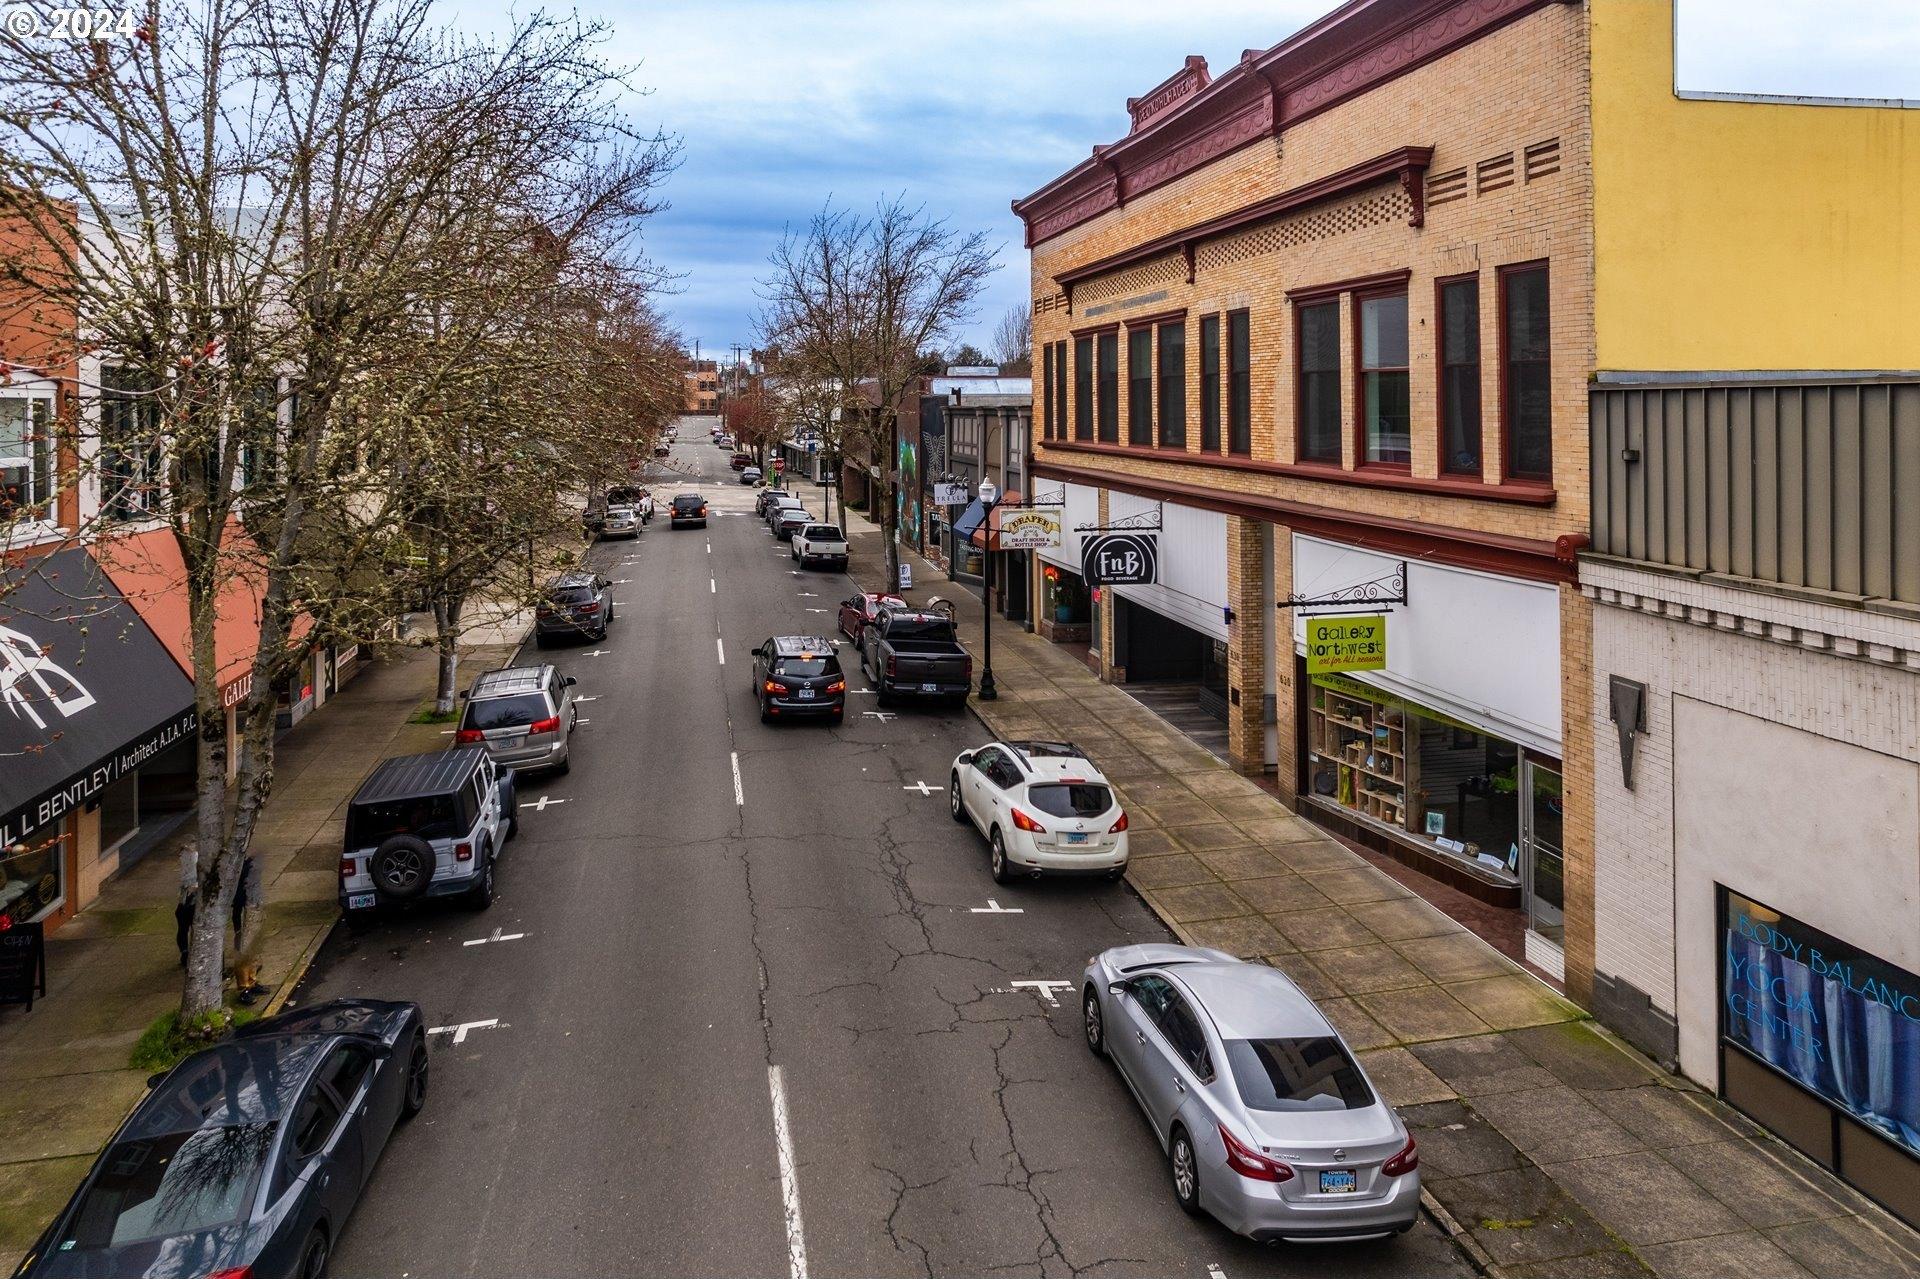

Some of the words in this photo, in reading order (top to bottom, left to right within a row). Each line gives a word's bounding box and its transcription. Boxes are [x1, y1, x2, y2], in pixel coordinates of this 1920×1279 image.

[1011, 514, 1050, 528] DRAPER
[1101, 551, 1140, 576] FnB
[1330, 656, 1342, 667] for
[1356, 655, 1383, 663] reasons
[22, 814, 34, 836] L
[38, 762, 112, 826] BENTLEY
[121, 736, 158, 774] Architect
[160, 723, 182, 749] A.I.A.
[1738, 913, 1803, 961] BODY
[1727, 949, 1819, 1024] YOGA
[1730, 993, 1824, 1063] CENTER
